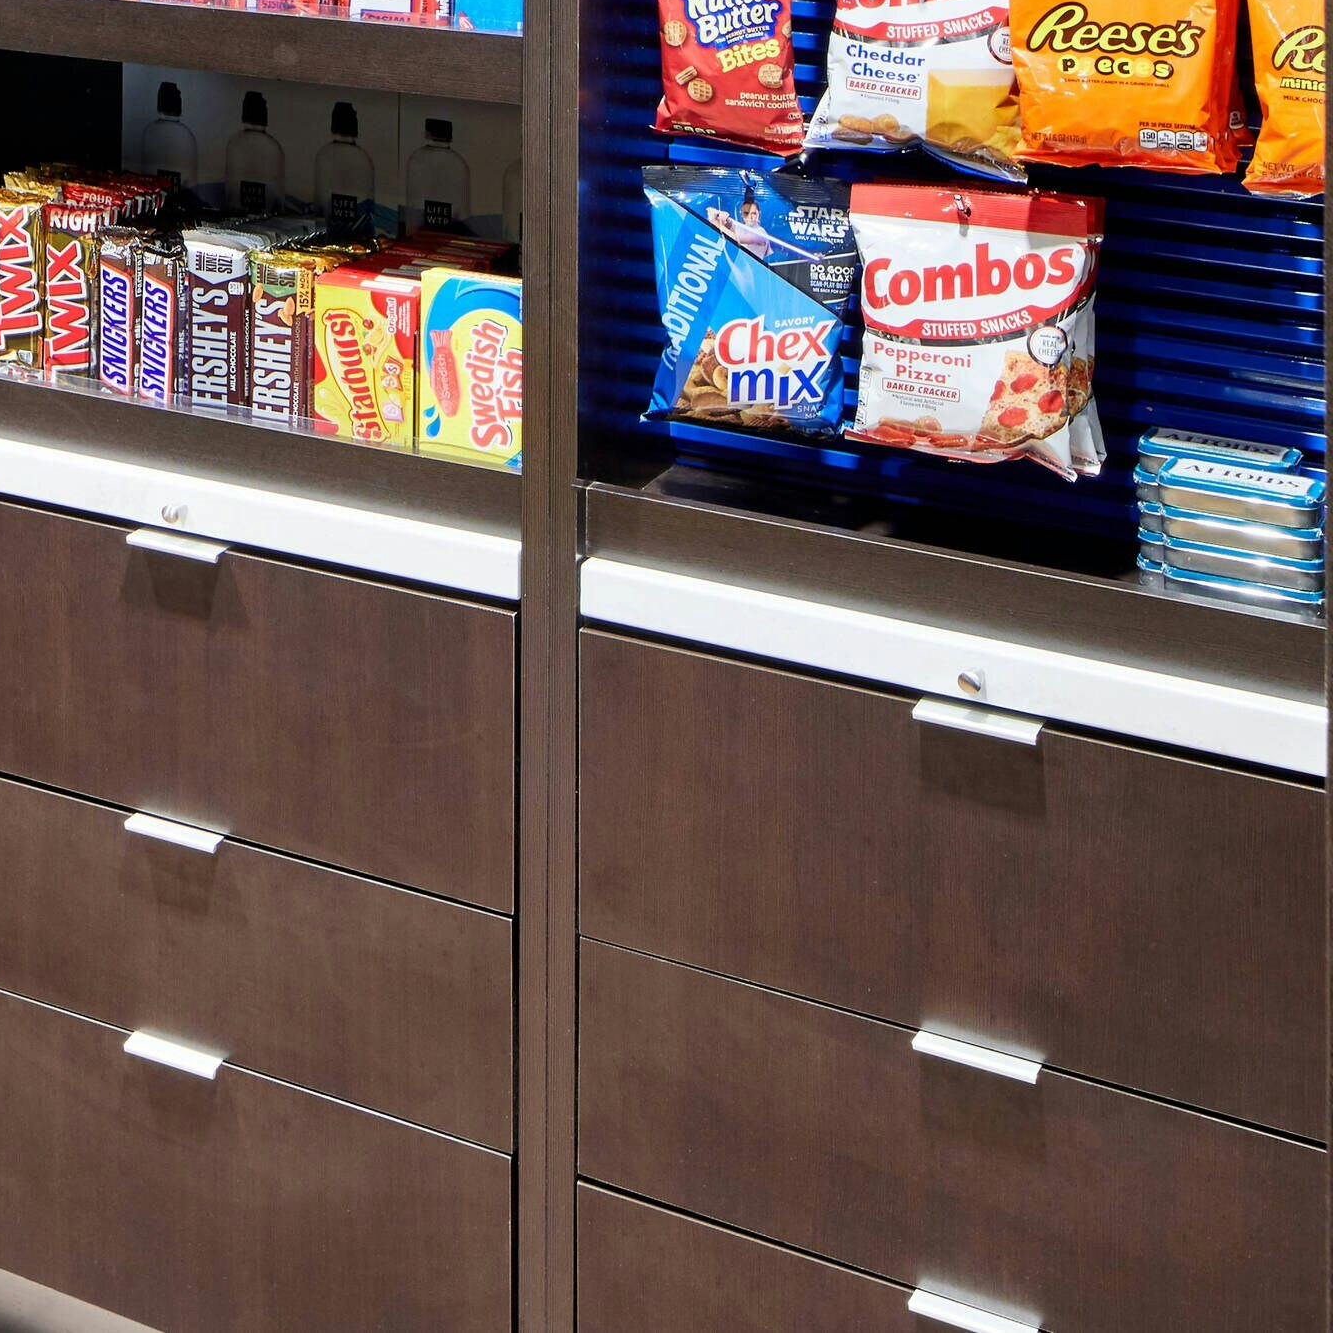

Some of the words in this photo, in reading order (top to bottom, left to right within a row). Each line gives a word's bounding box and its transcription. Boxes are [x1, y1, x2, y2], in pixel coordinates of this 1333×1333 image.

[696, 3, 779, 44] Butter
[886, 21, 940, 39] STUFFED
[944, 11, 994, 35] SNACKS
[1030, 4, 1201, 57] Reese's
[716, 39, 781, 73] Bites
[846, 44, 925, 67] Cheddar
[851, 63, 918, 83] Cheese
[740, 91, 769, 101] peanut
[848, 80, 877, 91] BAKED
[879, 83, 919, 97] CRACKER
[725, 99, 764, 108] sandwich
[1142, 131, 1155, 140] 150
[83, 192, 113, 205] FOUR
[428, 204, 450, 216] LIFE
[789, 205, 848, 221] STAR
[789, 221, 849, 238] WARS
[810, 264, 825, 273] DO
[827, 265, 854, 275] GOOD
[864, 242, 1076, 309] Combos
[45, 241, 90, 379] TWIX
[299, 290, 310, 309] 15%
[387, 298, 397, 335] Original
[774, 315, 816, 329] SAVORY
[921, 322, 977, 337] STUFFED
[981, 310, 1033, 333] SNACKS
[101, 268, 128, 390] SNICKERS
[141, 281, 169, 399] SNICKERS
[229, 331, 237, 373] CHOCOLATE
[716, 315, 836, 372] Chex
[873, 342, 972, 368] Pepperoni
[1042, 340, 1058, 348] REAL
[324, 312, 383, 441] Starburst
[471, 322, 507, 449] Swedish
[730, 362, 825, 409] mix
[896, 364, 947, 384] Pizza
[886, 381, 915, 392] BAKED
[917, 386, 957, 399] CRACKER
